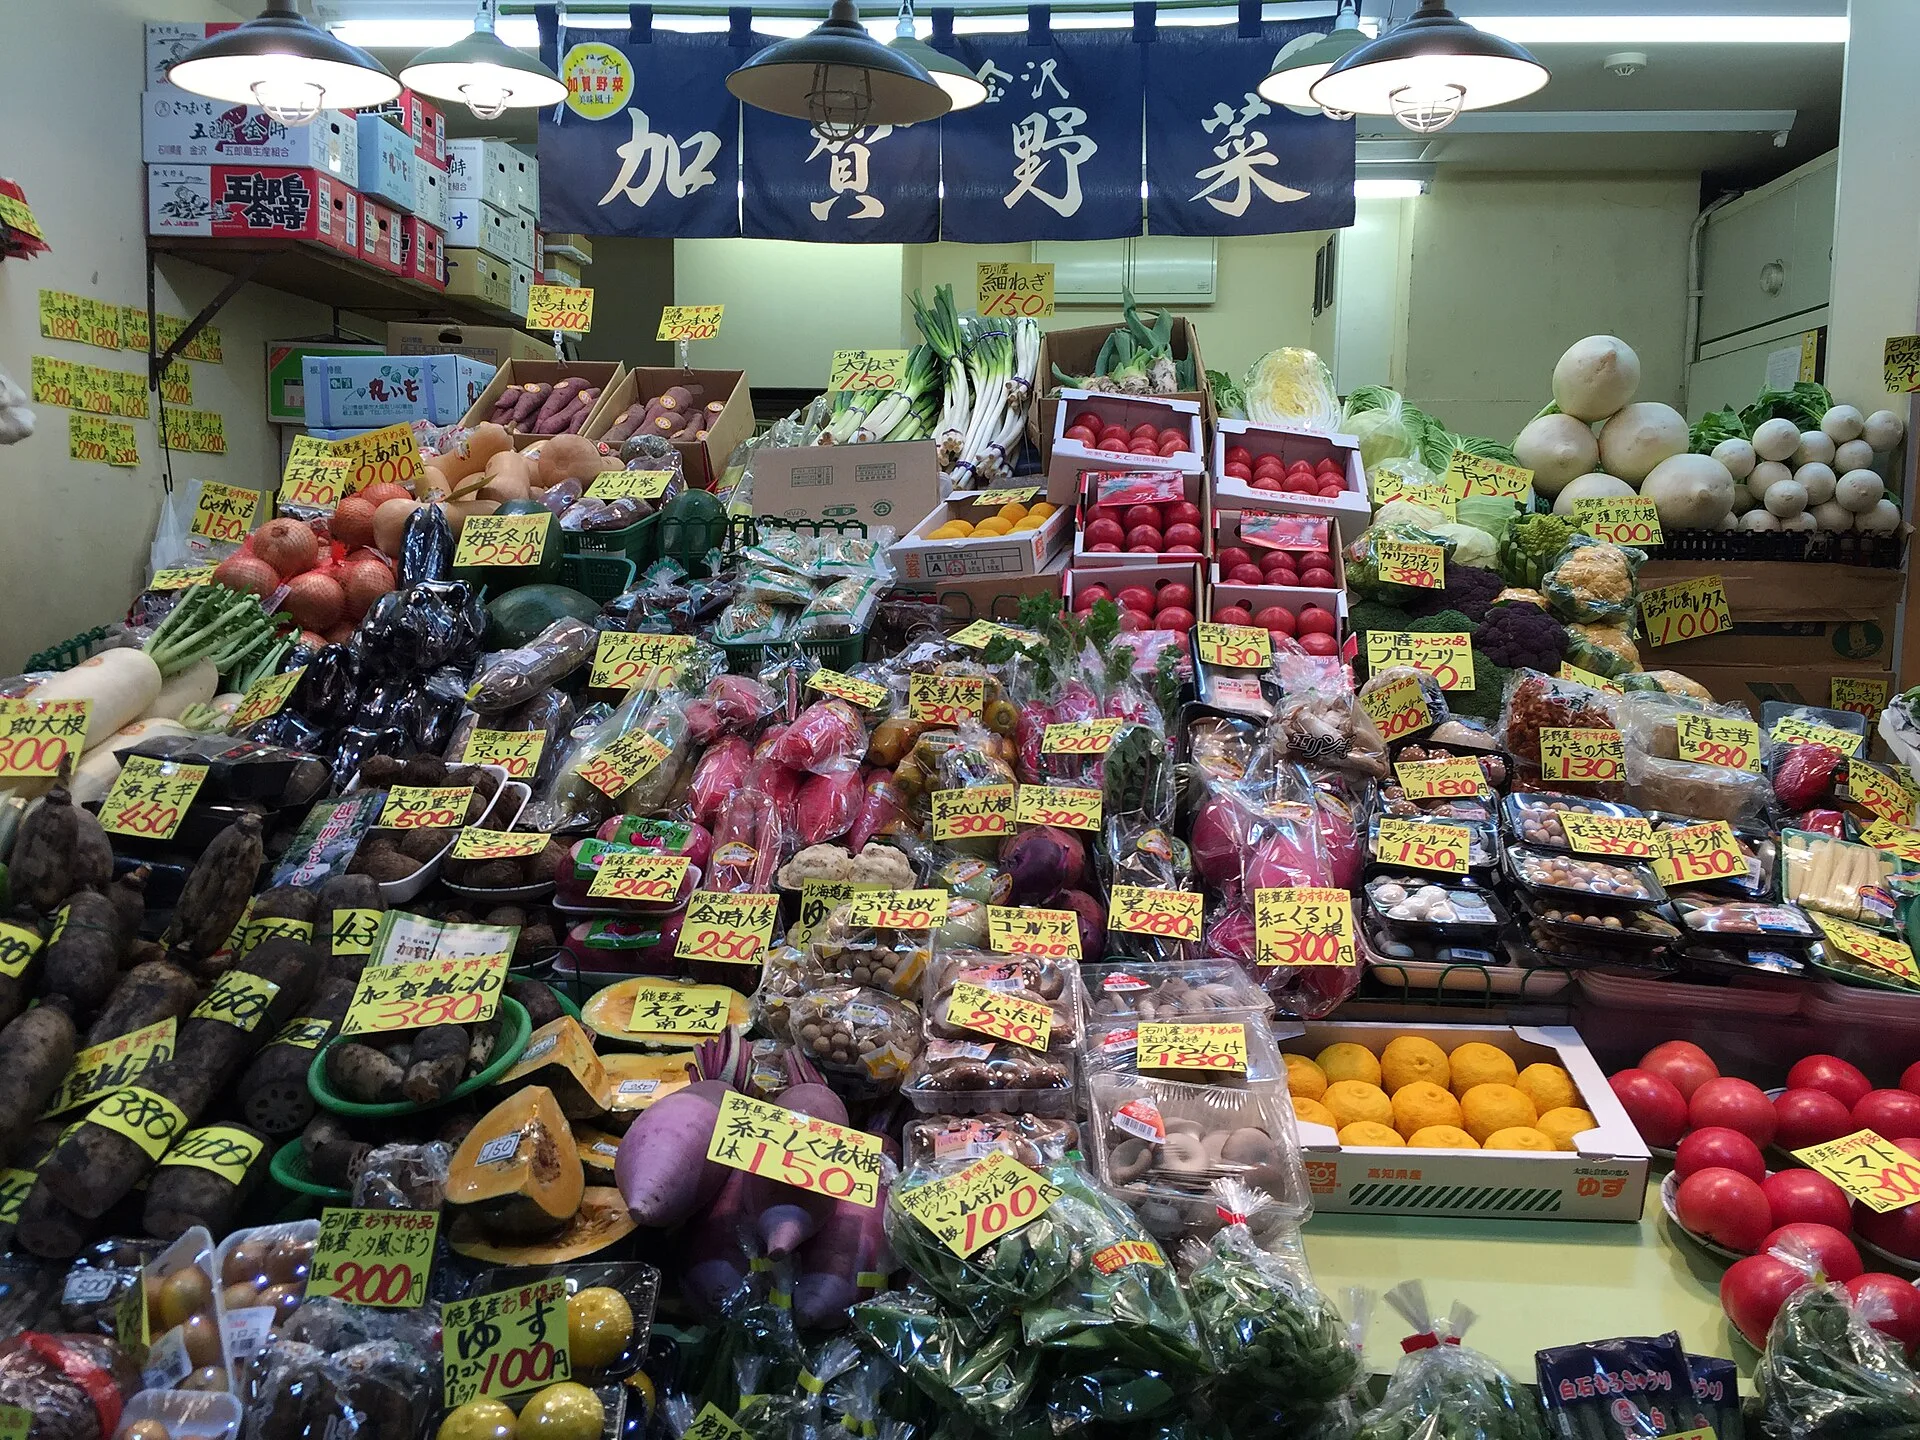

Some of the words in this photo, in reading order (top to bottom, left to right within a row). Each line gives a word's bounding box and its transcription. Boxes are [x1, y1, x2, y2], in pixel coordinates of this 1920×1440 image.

[974, 58, 1070, 104] 金沢
[223, 171, 311, 204] 五郎島
[241, 200, 310, 230] 金時
[532, 298, 590, 312] さつまいも
[369, 378, 420, 402] 丸いも
[1451, 464, 1526, 493] キャベツ
[200, 493, 255, 518] じゃがいも
[1581, 507, 1659, 524] 聖護院大根
[464, 526, 544, 547] 姫冬瓜
[1381, 550, 1440, 561] カリフラワー
[932, 563, 942, 572] A
[1645, 590, 1726, 618] あわじ島レタス
[1368, 633, 1413, 648] 石川産
[1413, 635, 1468, 647] サービス品
[1372, 646, 1468, 666] ブロッコリー
[913, 686, 982, 704] 金美人参
[470, 739, 533, 757] 京いも
[1544, 741, 1626, 758] かきの木茸
[120, 780, 197, 806] 海老芋
[1022, 795, 1100, 811] うずまきビーツ
[1380, 830, 1463, 849] マッシュルーム
[1568, 824, 1652, 841] むきぎんなん
[605, 866, 678, 881] 赤かぶ
[804, 883, 854, 900] 北海道産
[1121, 898, 1203, 916] 黒だいこん
[688, 904, 776, 933] 金時人参
[1258, 905, 1343, 928] 紅くるり
[1295, 922, 1346, 937] 大根
[641, 1001, 728, 1019] えびす
[979, 1000, 1048, 1030] しいたけ
[656, 1015, 718, 1031] 南瓜
[1142, 1041, 1243, 1054] ひらたけ
[1822, 1144, 1894, 1183] トマト
[1368, 1168, 1422, 1180] 高知県産
[1576, 1179, 1628, 1198] ゆず
[1559, 1370, 1672, 1400] 白石もろきゅうり
